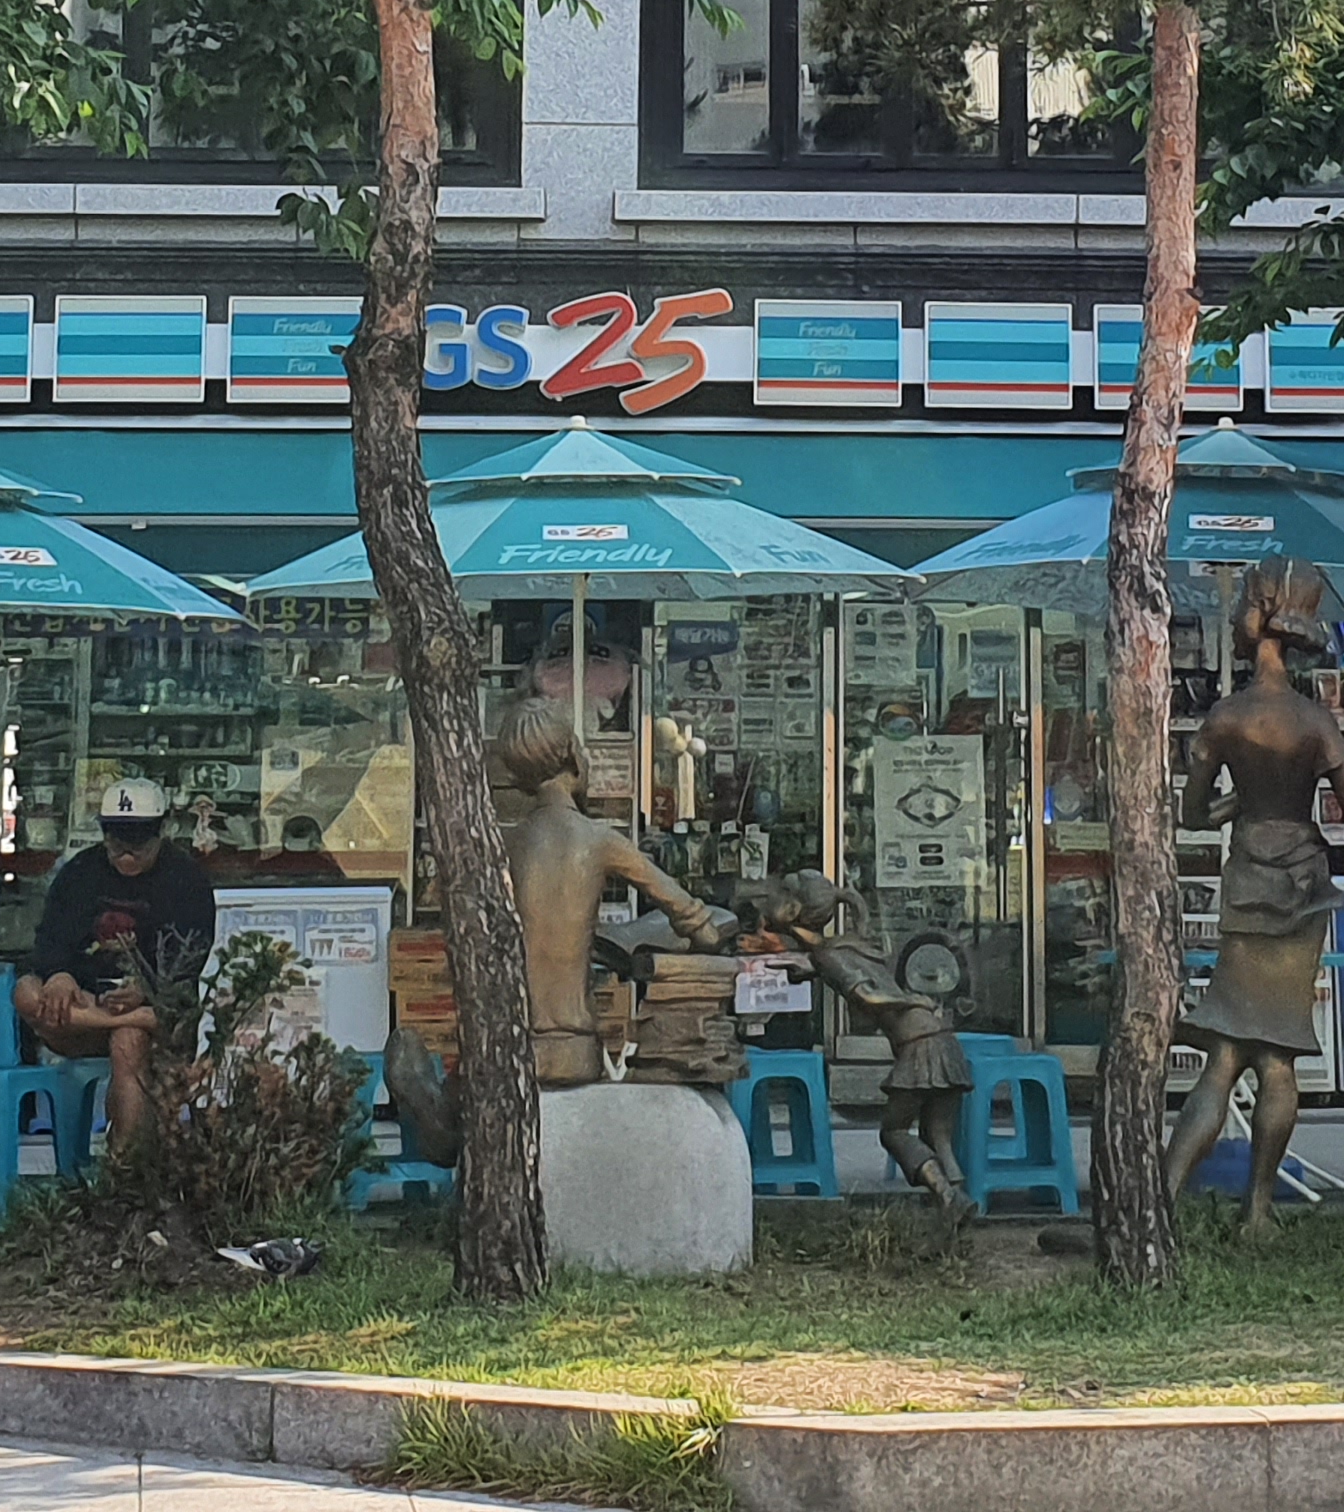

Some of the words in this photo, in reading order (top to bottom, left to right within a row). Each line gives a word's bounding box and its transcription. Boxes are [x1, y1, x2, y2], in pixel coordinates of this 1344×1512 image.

[273, 317, 334, 336] Friendly
[798, 322, 856, 339] Friendly
[423, 288, 734, 415] GS25
[286, 358, 318, 373] Fun
[812, 361, 841, 376] Fun
[759, 543, 833, 565] Fun
[1181, 535, 1284, 554] Fresh
[497, 543, 674, 567] Friendly
[118, 789, 134, 812] LA
